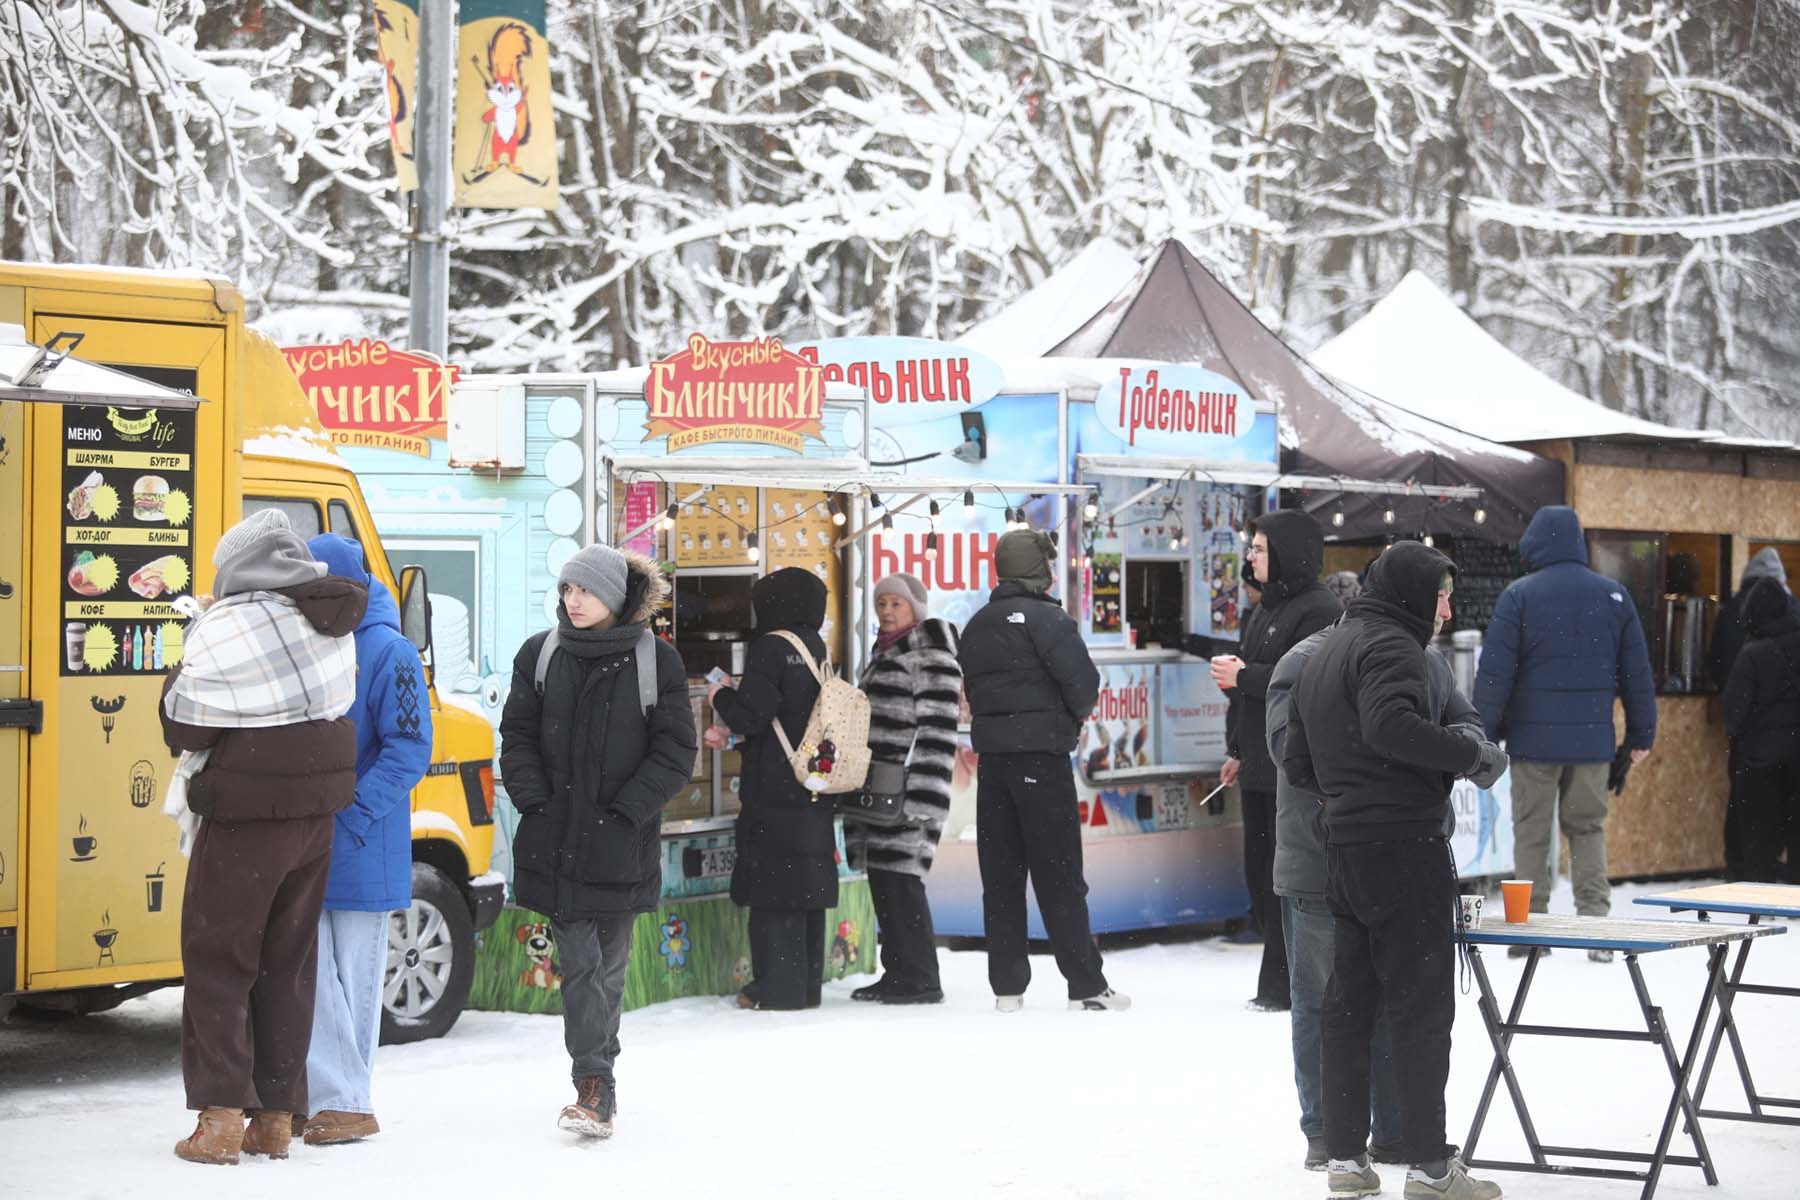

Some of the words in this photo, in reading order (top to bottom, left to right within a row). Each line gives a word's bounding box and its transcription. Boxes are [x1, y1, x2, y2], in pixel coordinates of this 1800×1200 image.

[285, 341, 389, 375] усные
[690, 334, 783, 379] Вкусные
[1119, 367, 1238, 447] Трдельник
[67, 427, 102, 441] МЕНЮ
[152, 421, 176, 449] life
[353, 433, 423, 454] ПИТАНИЯ
[673, 434, 701, 449] КАФЕ
[702, 427, 753, 440] БЫСТРОГО
[754, 428, 800, 449] ПИТАНИЯ
[75, 453, 114, 465] ШАУРМА
[149, 456, 181, 467] БУРГЕР
[76, 530, 112, 541] ХОТ-ДОГ
[148, 532, 180, 543] БЛИНЫ
[80, 605, 105, 615] КОФЕ
